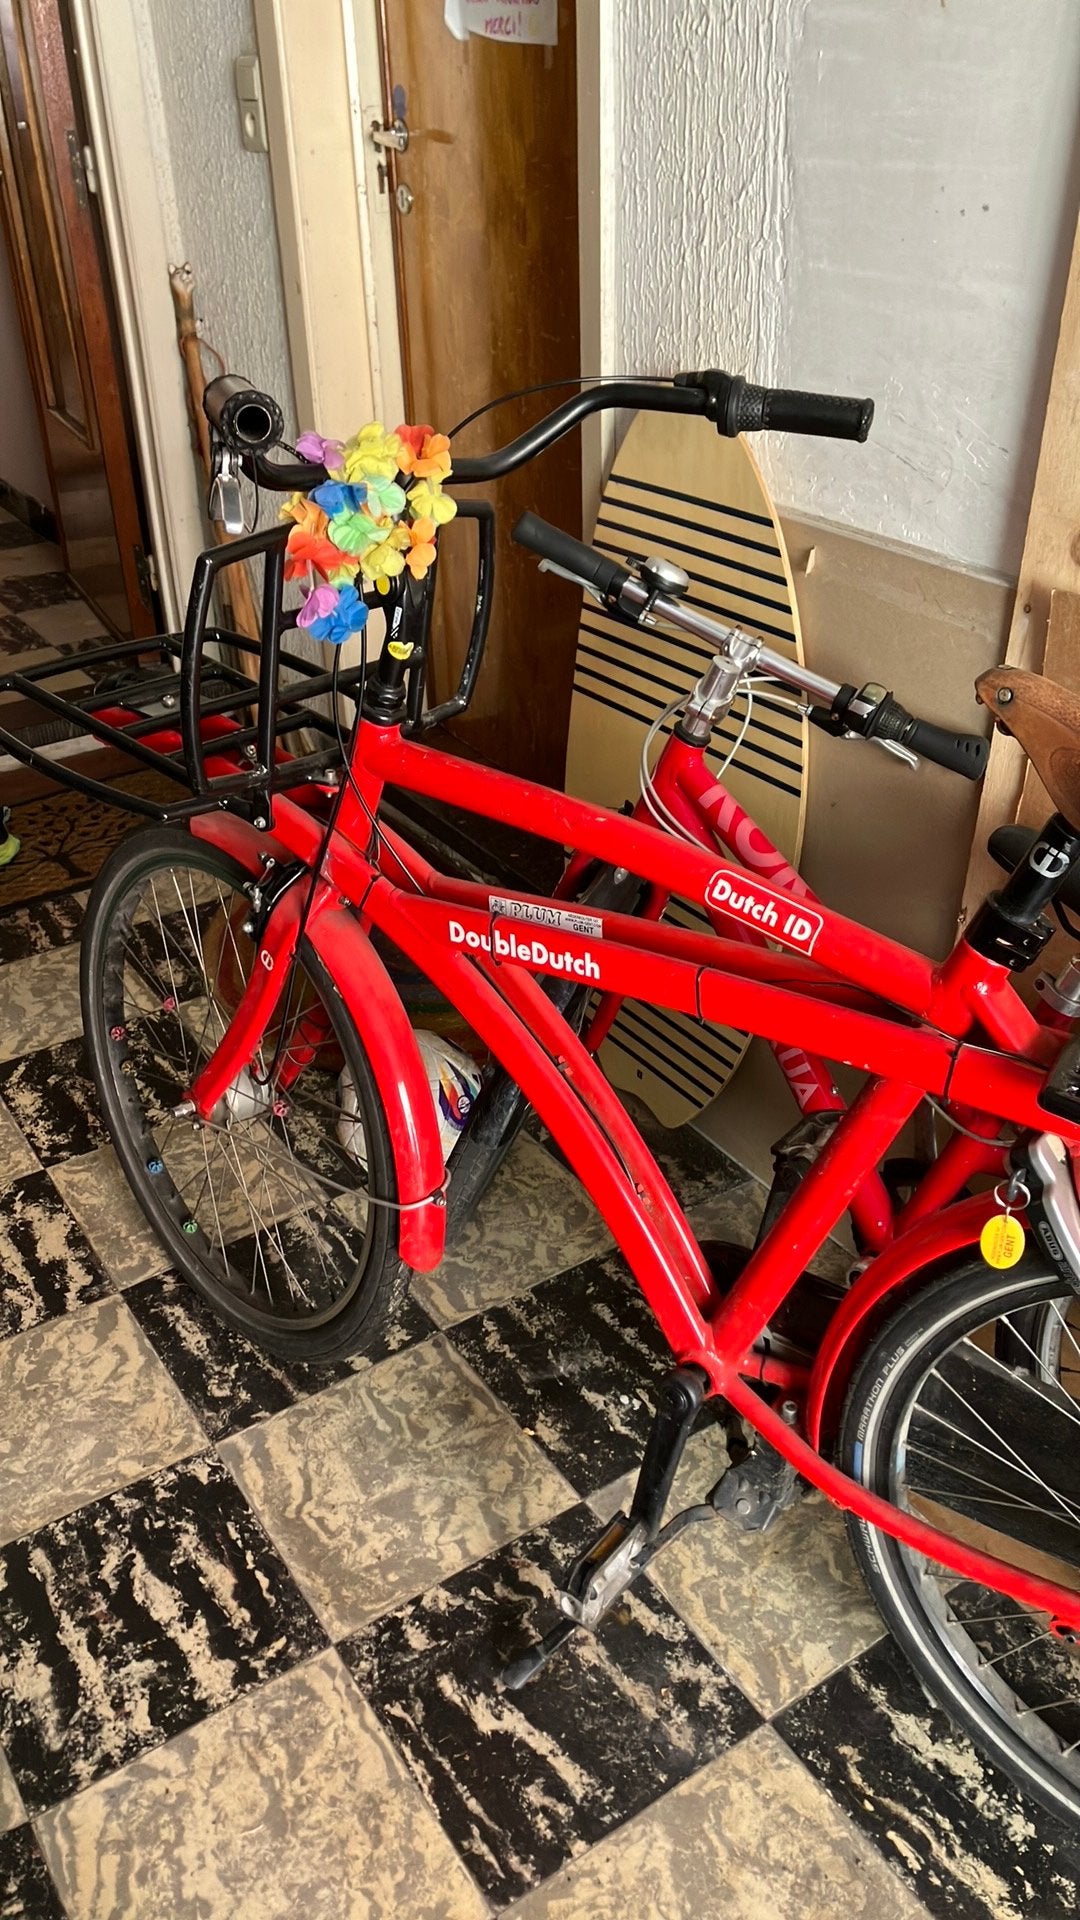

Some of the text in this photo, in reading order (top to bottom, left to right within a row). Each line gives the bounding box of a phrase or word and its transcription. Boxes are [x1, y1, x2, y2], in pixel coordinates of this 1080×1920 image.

[511, 902, 562, 926] PLUM
[572, 923, 594, 935] GENT
[711, 877, 813, 942] Dutch ID
[448, 919, 601, 980] DoubleDutch
[1002, 1233, 1017, 1259] GENT
[856, 1345, 906, 1442] MARATHON PLUS
[858, 1517, 881, 1575] SCHWAL
